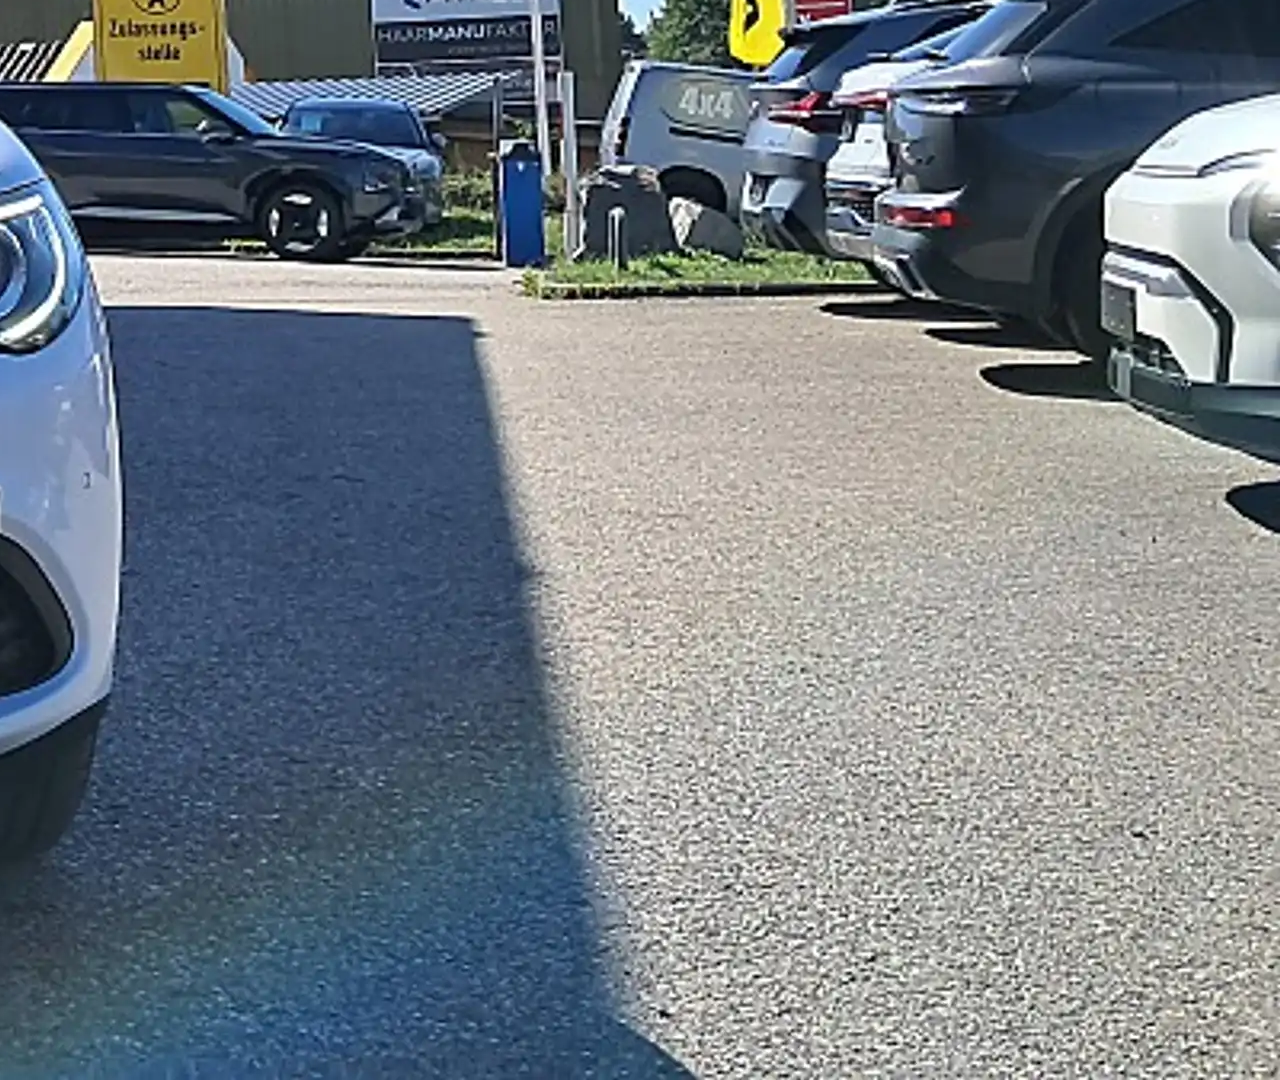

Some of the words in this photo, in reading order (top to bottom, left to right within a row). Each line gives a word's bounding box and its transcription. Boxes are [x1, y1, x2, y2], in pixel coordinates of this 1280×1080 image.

[109, 17, 205, 41] Zulassungs-
[377, 21, 556, 43] HAARMANUFAKTR
[678, 87, 734, 119] 4x4
